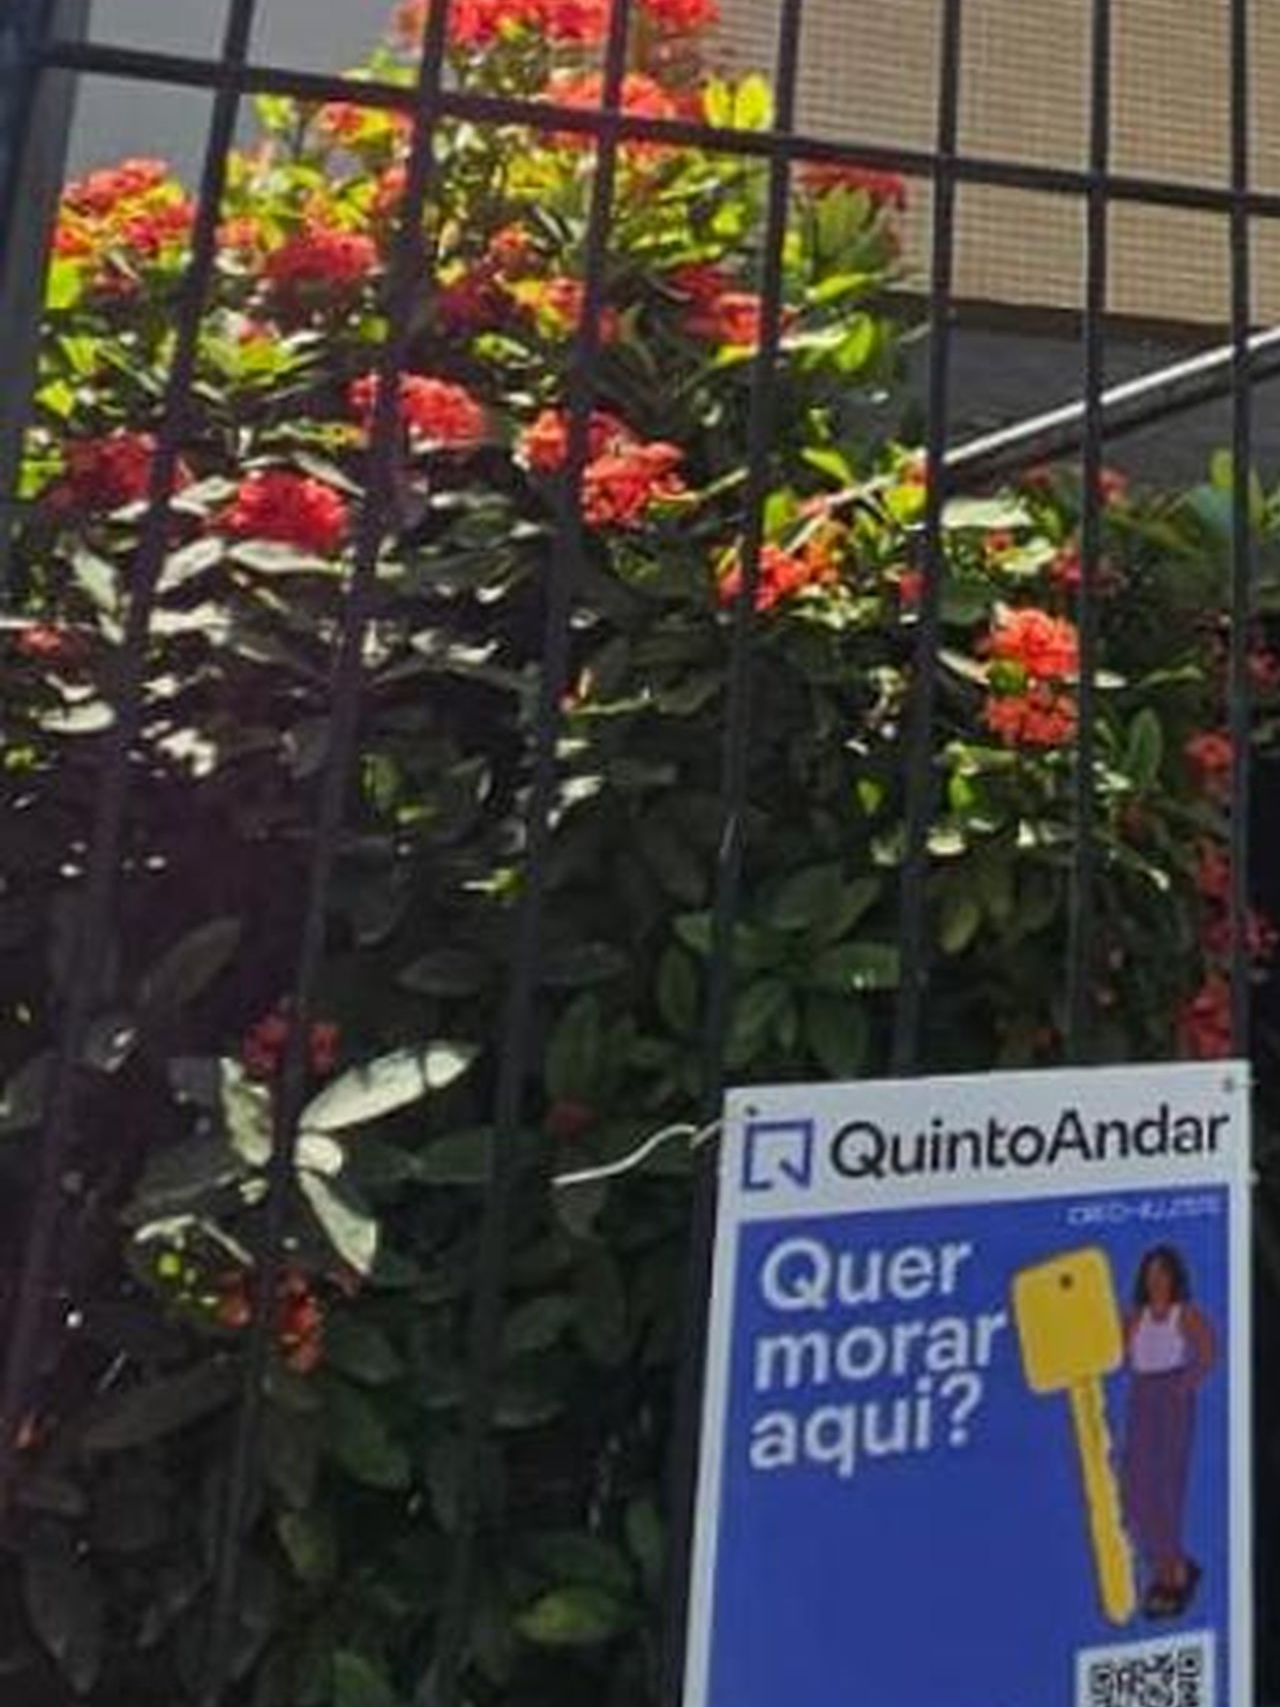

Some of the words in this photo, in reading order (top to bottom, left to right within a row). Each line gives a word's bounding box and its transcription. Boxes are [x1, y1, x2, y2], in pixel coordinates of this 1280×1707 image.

[831, 1104, 1230, 1180] QuintoAndar
[761, 1238, 971, 1311] Quer
[756, 1310, 1007, 1390] morar
[750, 1374, 984, 1477] aqui?
